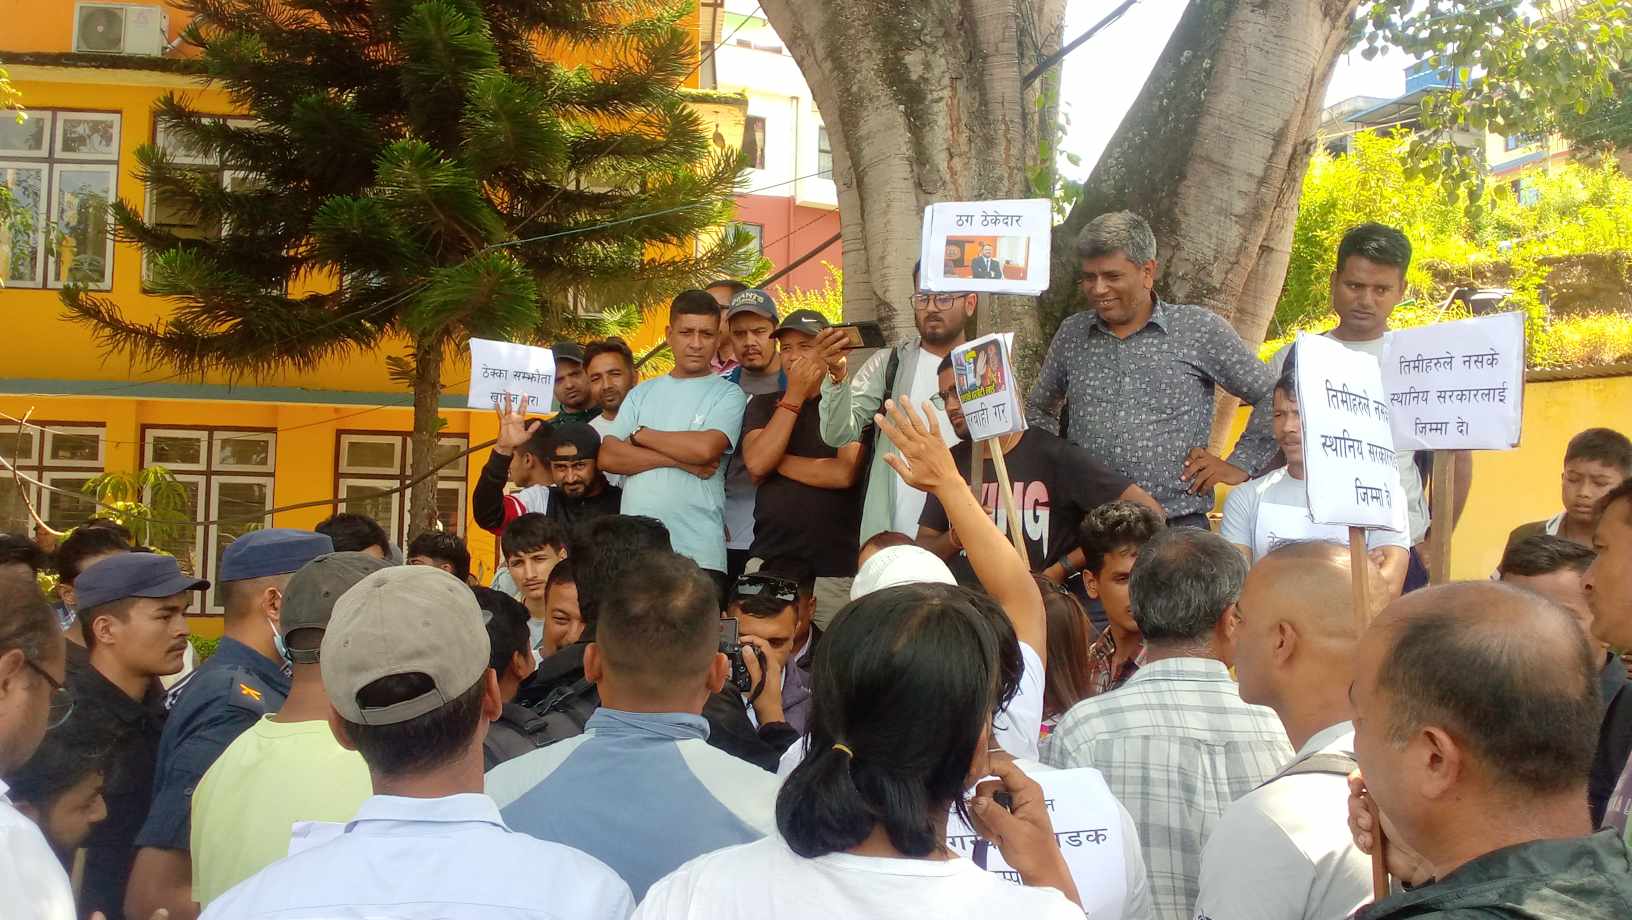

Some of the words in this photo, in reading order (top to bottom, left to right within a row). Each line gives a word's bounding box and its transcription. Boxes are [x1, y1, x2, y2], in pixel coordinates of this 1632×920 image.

[956, 214, 975, 227] ठग
[980, 210, 1023, 227] ठेकेदार
[1462, 347, 1500, 369] नसके
[481, 363, 508, 380] ठेक्का
[1390, 385, 1431, 406] स्थानिय
[1436, 381, 1509, 405] सरकारलाई
[1414, 417, 1450, 436] जिम्मा
[1320, 429, 1364, 460] स्थानिय
[1355, 477, 1384, 507] जिम्मा
